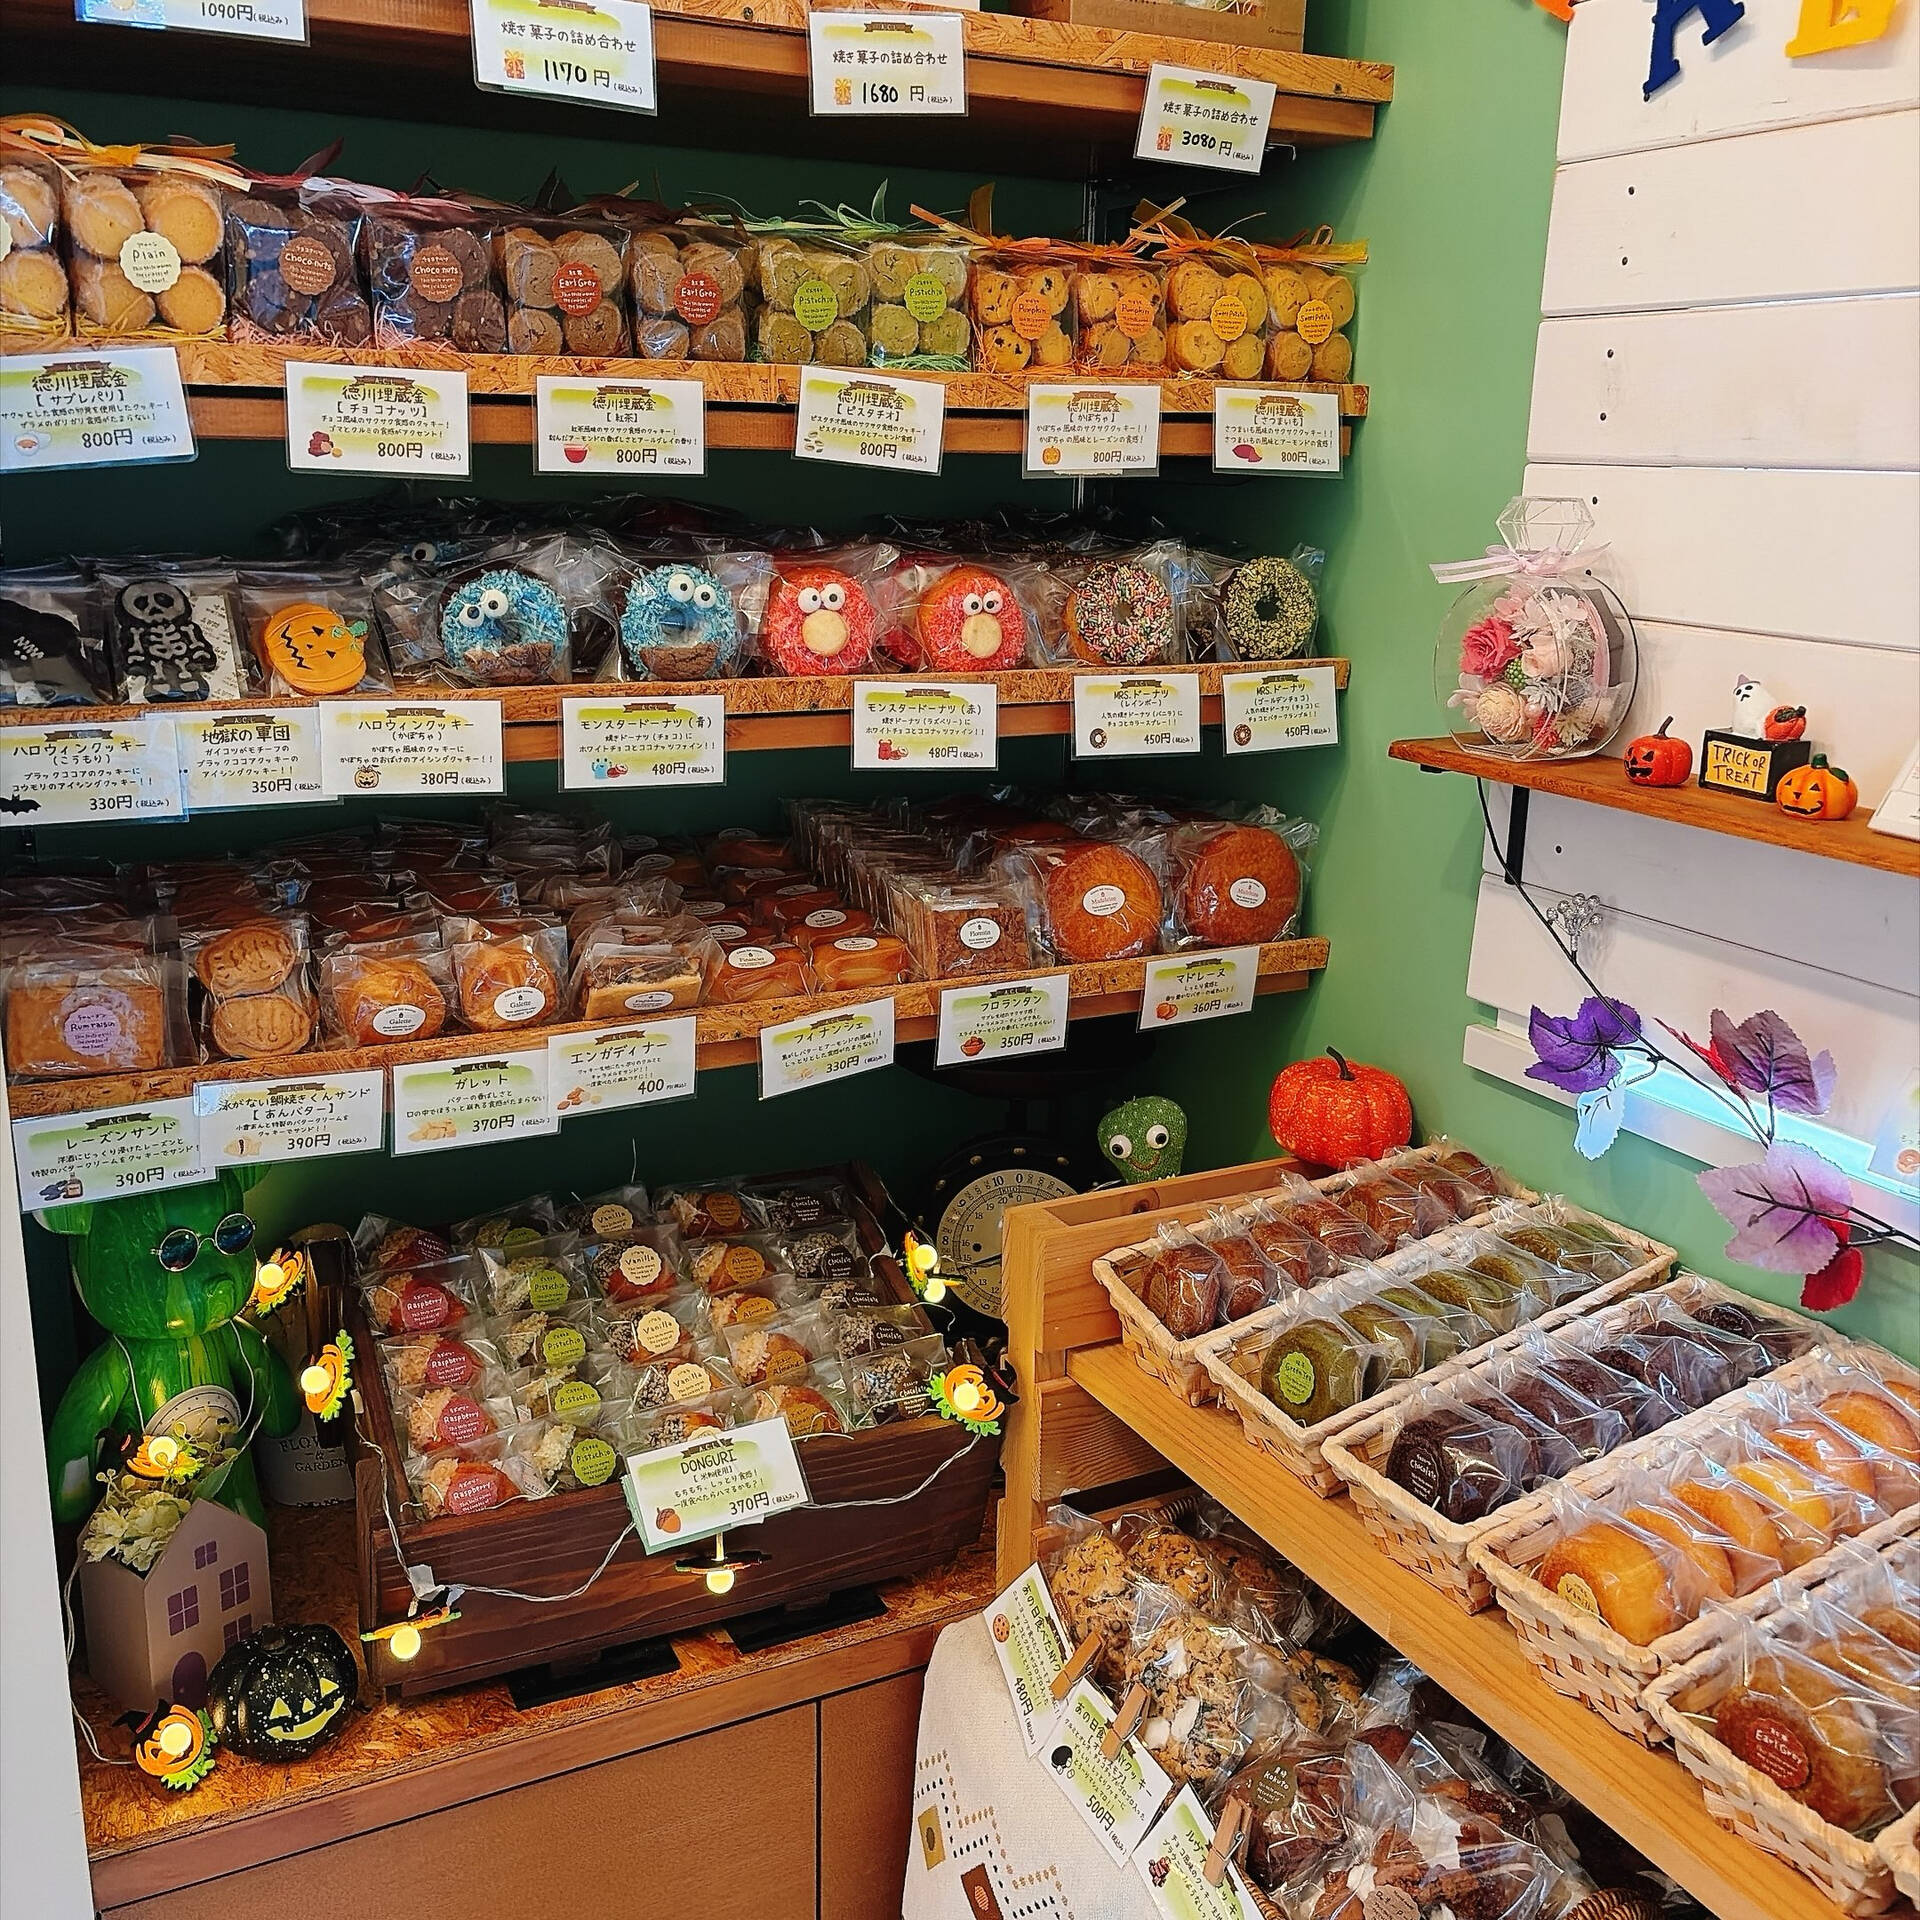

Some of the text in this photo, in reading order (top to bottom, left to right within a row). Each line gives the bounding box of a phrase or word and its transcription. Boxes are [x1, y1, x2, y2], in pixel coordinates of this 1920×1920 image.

[501, 21, 637, 53] 焼き菓子の詰め合わせ
[833, 50, 948, 65] 焼き菓子の詰め合わせ
[1163, 101, 1258, 126] 焼き菓子の詰め合わせ
[132, 249, 166, 262] Plain
[285, 253, 332, 271] Choco nuts
[414, 266, 459, 274] Choco nuts
[559, 279, 596, 288] Earl Grey
[681, 288, 717, 298] Earl Grey
[32, 370, 128, 392] 徳川埋蔵金
[342, 385, 428, 405] 徳川埋蔵金
[838, 388, 906, 410] 徳川埋蔵金
[592, 396, 656, 411] 徳川埋蔵金
[1067, 401, 1122, 413] 徳川埋蔵金
[1256, 404, 1305, 417] 徳川埋蔵金
[606, 413, 638, 423] 【紅茶】
[837, 403, 900, 421] 【ピスタチオ】
[82, 428, 133, 448] 800円
[377, 442, 423, 458] 800円
[616, 449, 657, 464] 800円
[860, 442, 897, 459] 800円
[1093, 451, 1121, 463] 800円
[1281, 451, 1307, 463] 800円
[358, 719, 474, 730] ハロウィンクッキー
[1285, 725, 1309, 737] 450円
[202, 725, 290, 744] 地獄の軍団
[1144, 733, 1171, 744] 450円
[13, 740, 147, 756] ハロウィンクッキー
[205, 745, 289, 756] ガイコツがモチーフの
[928, 746, 958, 759] 480円
[1713, 745, 1766, 768] TRICK OR
[652, 762, 685, 775] 480円
[1713, 764, 1762, 788] TREAT
[252, 778, 291, 793] 350円
[421, 771, 458, 785] 380円
[90, 795, 132, 810] 330円
[1177, 968, 1225, 983] マドレーヌ
[981, 996, 1041, 1012] フロランタン
[1192, 1000, 1221, 1014] 360円
[794, 1022, 863, 1044] フィナンシェ
[1000, 1032, 1034, 1048] 350円
[570, 1041, 667, 1064] エンガディナー
[826, 1055, 860, 1073] 330円
[455, 1074, 508, 1090] ガレット
[637, 1079, 665, 1095] 400
[472, 1114, 514, 1132] 370円
[66, 1121, 176, 1150] レーズンサンド
[287, 1133, 330, 1150] 390円
[116, 1166, 164, 1188] 390円
[992, 1176, 1004, 1186] 10
[1016, 1173, 1023, 1183] 0
[942, 1236, 948, 1245] 8
[625, 1256, 655, 1265] Vanilla
[643, 1321, 672, 1334] Vanilla
[673, 1373, 703, 1387] Vanilla
[443, 1411, 479, 1423] Raspberry
[680, 1449, 737, 1475] DONGURI
[453, 1482, 492, 1500] Raspberry
[728, 1491, 770, 1516] 370円
[1014, 1676, 1034, 1716] 480円
[1755, 1730, 1779, 1750] Earl
[1779, 1745, 1802, 1764] Grey
[1086, 1794, 1116, 1832] 500円
